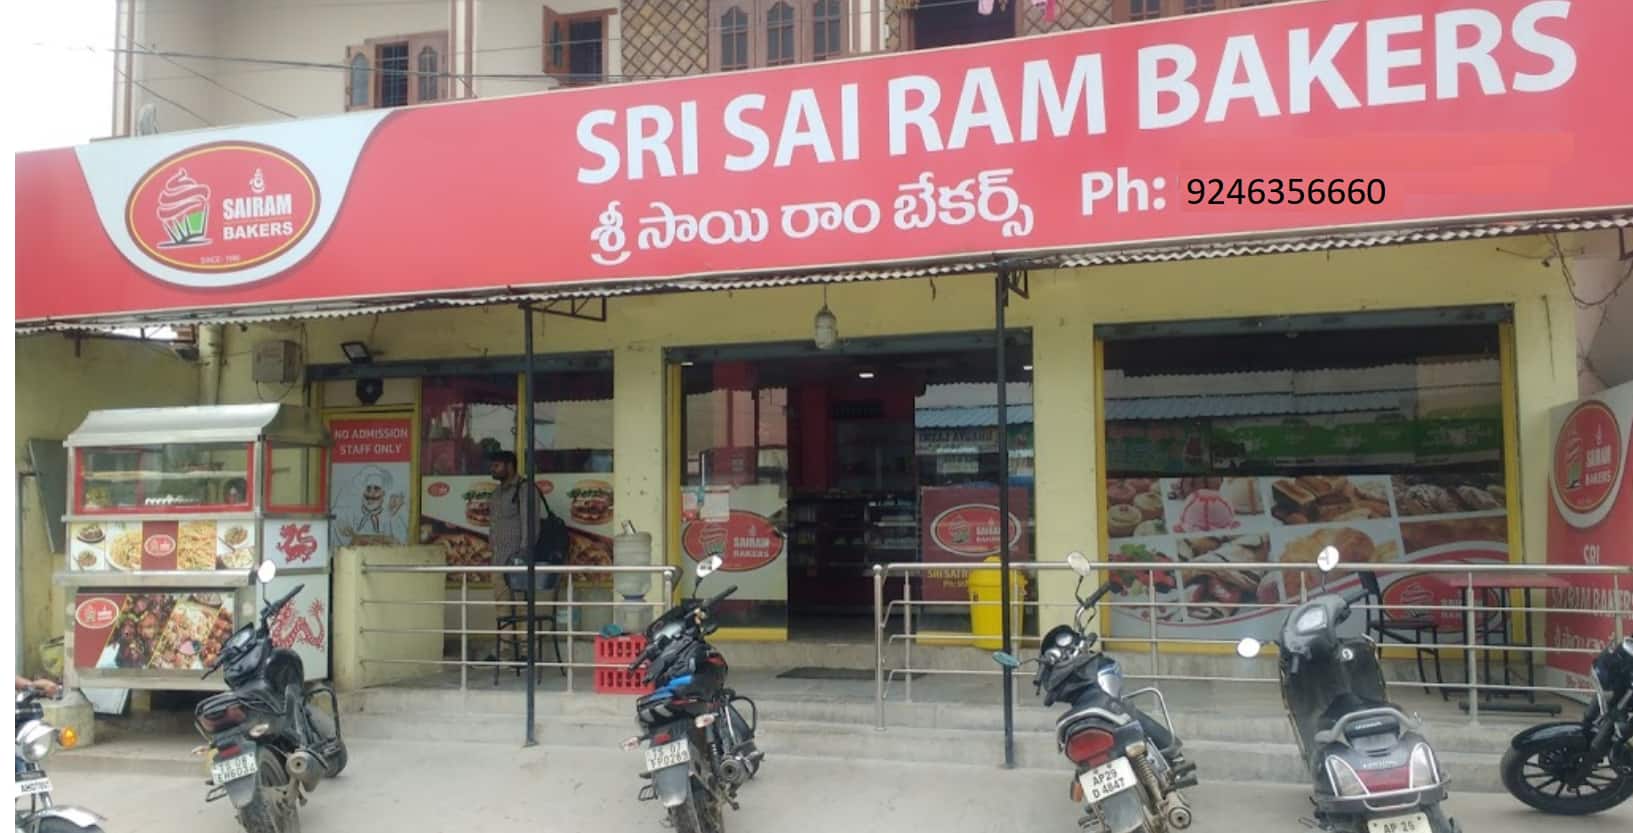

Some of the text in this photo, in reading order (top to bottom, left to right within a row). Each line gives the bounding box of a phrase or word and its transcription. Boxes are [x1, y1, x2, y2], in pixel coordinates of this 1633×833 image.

[576, 0, 1577, 185] SRI SAI RAM BAKERS
[1081, 167, 1166, 216] Ph:
[223, 193, 292, 220] SAIRAM
[223, 221, 293, 240] BAKERS
[590, 201, 631, 265] శ్రీ
[638, 201, 769, 249] సాయి
[781, 199, 880, 238] రాం
[335, 426, 408, 440] NO ADMISSION
[340, 443, 402, 456] STAFF ONLY
